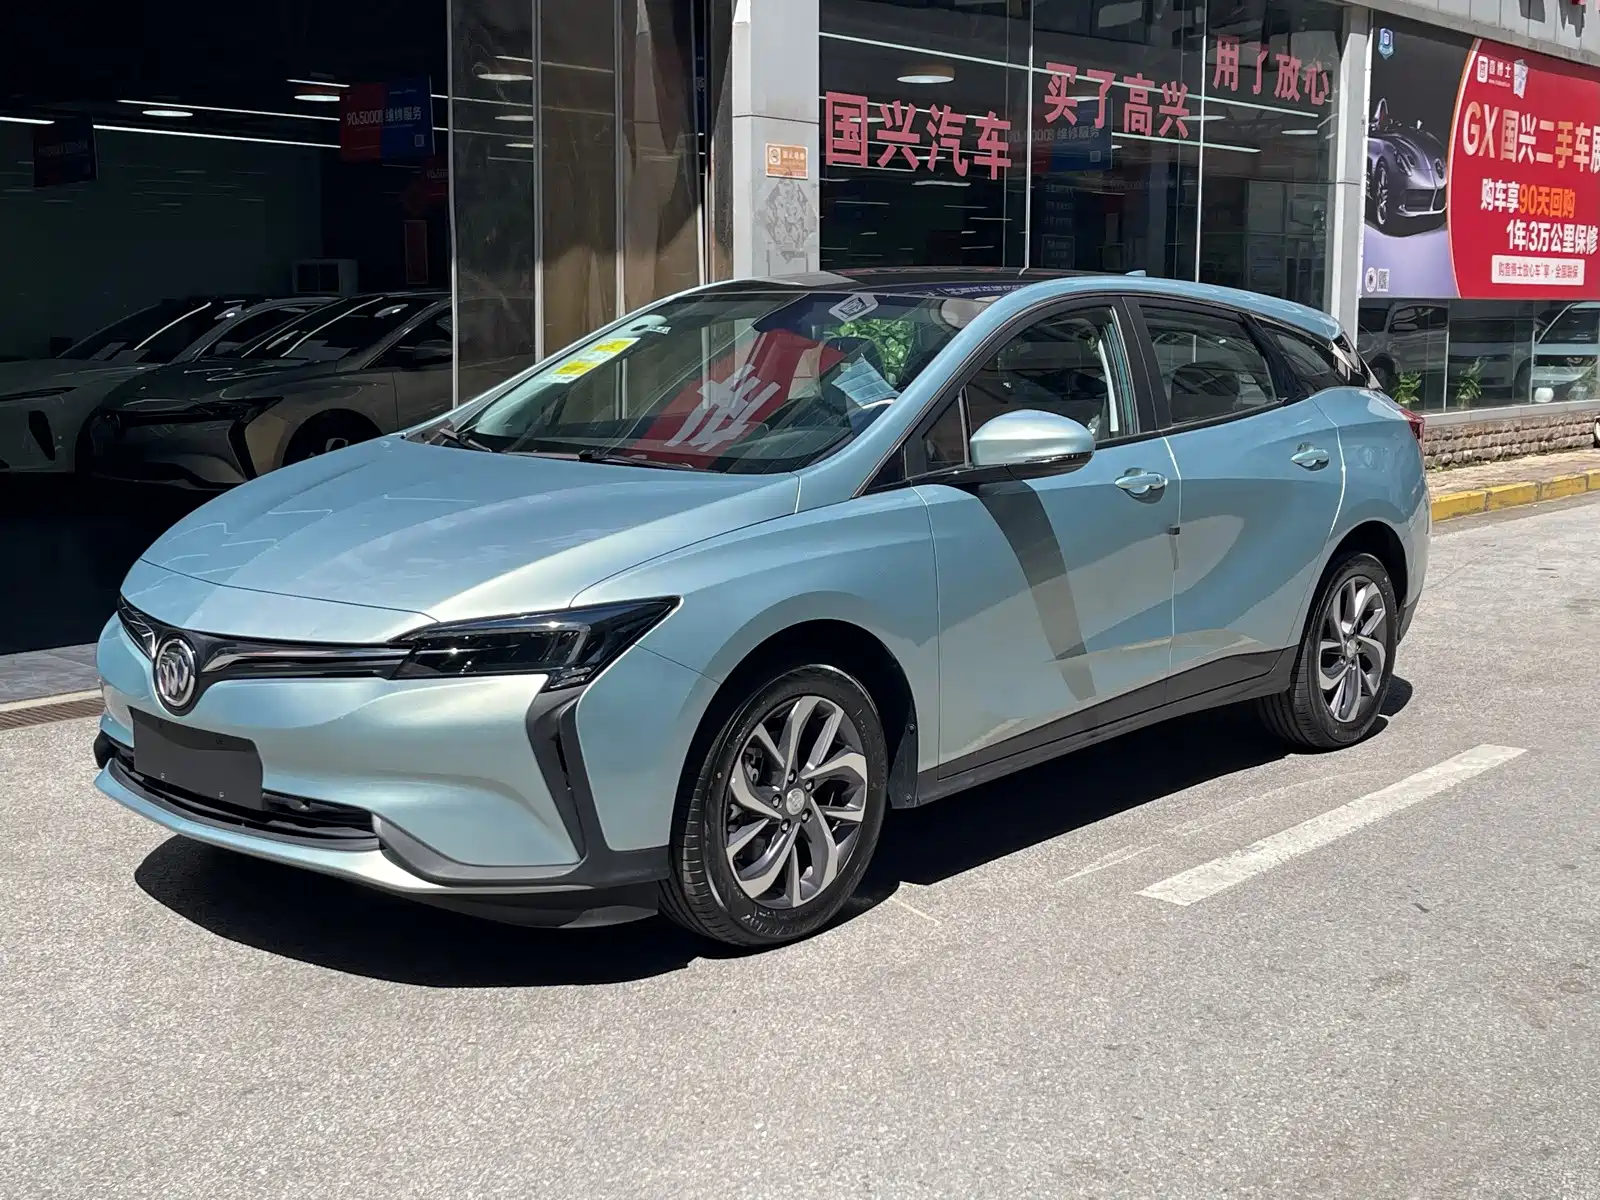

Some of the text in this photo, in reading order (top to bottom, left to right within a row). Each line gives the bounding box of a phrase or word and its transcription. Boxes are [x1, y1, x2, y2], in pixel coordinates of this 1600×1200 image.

[825, 35, 1330, 180] 国兴汽车 买了高兴 用了放心
[1480, 178, 1575, 218] 购车享90天回购
